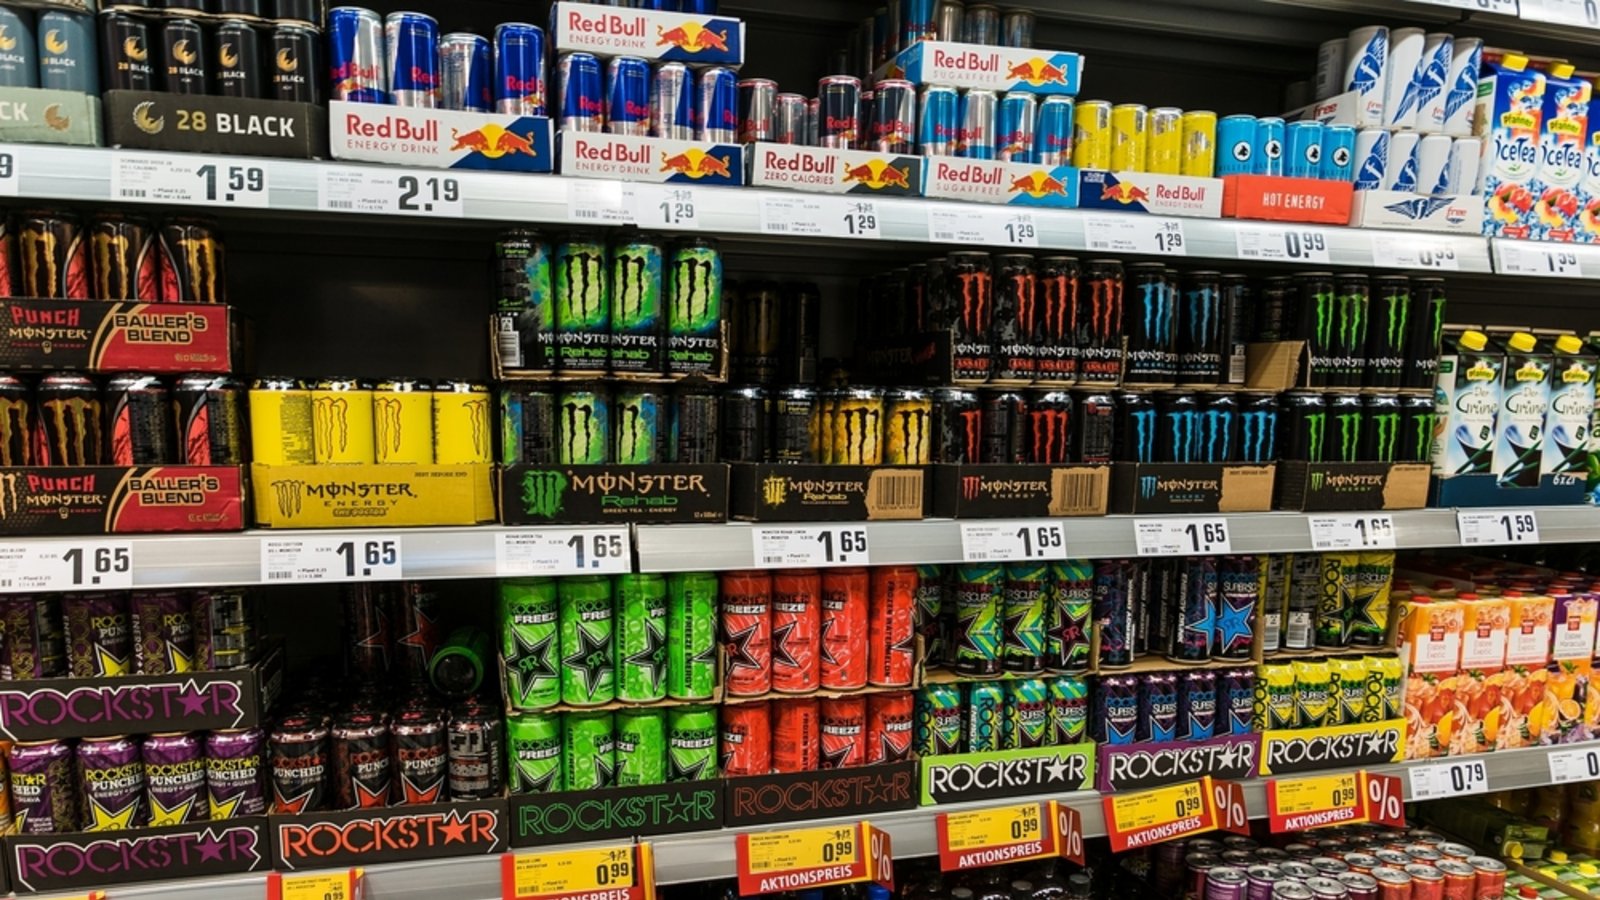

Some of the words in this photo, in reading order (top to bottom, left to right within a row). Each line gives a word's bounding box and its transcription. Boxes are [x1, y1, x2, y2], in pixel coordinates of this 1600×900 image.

[569, 12, 605, 33] Red
[610, 14, 646, 37] Bull
[569, 34, 610, 46] ENERGY
[615, 37, 646, 49] DRINK
[349, 63, 379, 80] Bull
[934, 50, 966, 71] Red
[969, 53, 999, 73] Bull
[411, 67, 435, 82] Red
[506, 76, 533, 91] Red
[934, 70, 998, 83] SUGARFREE
[0, 103, 29, 121] CK
[176, 110, 207, 132] 28
[216, 113, 296, 138] BLACK
[347, 114, 390, 137] Red
[403, 116, 439, 142] Bull
[347, 139, 397, 153] ENERGY
[401, 142, 440, 155] DRINK
[576, 140, 612, 161] Red
[616, 142, 651, 164] Bull
[576, 162, 615, 174] ENERGY
[620, 164, 651, 176] DRINK
[765, 151, 800, 173] Red
[803, 154, 836, 176] Bull
[196, 164, 264, 202] 1.59
[764, 172, 790, 183] ZERO
[792, 175, 835, 186] CALORIES
[938, 164, 970, 183] Red
[972, 166, 1002, 184] Bull
[398, 175, 459, 212] 2.19
[936, 182, 1001, 196] SUGARFREE
[1156, 184, 1181, 201] Red
[1181, 185, 1206, 202] Bull
[1262, 192, 1281, 207] HOT
[1284, 194, 1325, 210] ENERGY
[659, 202, 694, 223] 1.29
[844, 213, 876, 235] 1.29
[1004, 223, 1035, 244] 1.29
[1155, 232, 1182, 252] 1.29
[1285, 231, 1326, 259] 0.99
[10, 306, 80, 326] PUNCH
[114, 313, 207, 331] BALLER'S
[9, 327, 87, 341] MONSTER
[126, 329, 193, 344] BLEND
[560, 346, 608, 358] Rehab
[27, 474, 95, 492] PUNCH
[128, 475, 220, 492] BALLER'S
[306, 481, 414, 499] MONSTER
[572, 472, 708, 495] MONSTER
[789, 479, 864, 493] MONSTER
[980, 479, 1048, 493] MONSTER
[1157, 478, 1219, 492] MONSTER
[1326, 474, 1383, 487] MONSTER
[26, 493, 103, 507] MONSTER
[140, 491, 204, 505] BLEND
[324, 499, 398, 507] ENERGY
[602, 494, 679, 508] Rehab
[803, 493, 848, 501] Rehab
[1185, 524, 1226, 552] 1.65
[1354, 518, 1391, 546] 1.65
[1500, 515, 1535, 541] 1.59
[567, 535, 623, 569] 1.65
[817, 530, 867, 562] 1.65
[1016, 527, 1062, 557] 1.65
[62, 547, 130, 586] 1.65
[336, 541, 397, 577] 1.65
[1587, 752, 1600, 777] 0
[1450, 764, 1484, 791] 0.79
[1176, 796, 1201, 818] 0.99
[1333, 788, 1355, 807] 0.99
[1285, 807, 1355, 830] AKTIONSPREIS
[1011, 818, 1039, 840] 0.99
[1127, 816, 1202, 848] AKTIONSPREIS
[822, 841, 853, 863] 0.99
[958, 840, 1043, 869] AKTIONSPREIS
[596, 862, 630, 886] 0.99
[758, 864, 853, 893] AKTIONSPREIS
